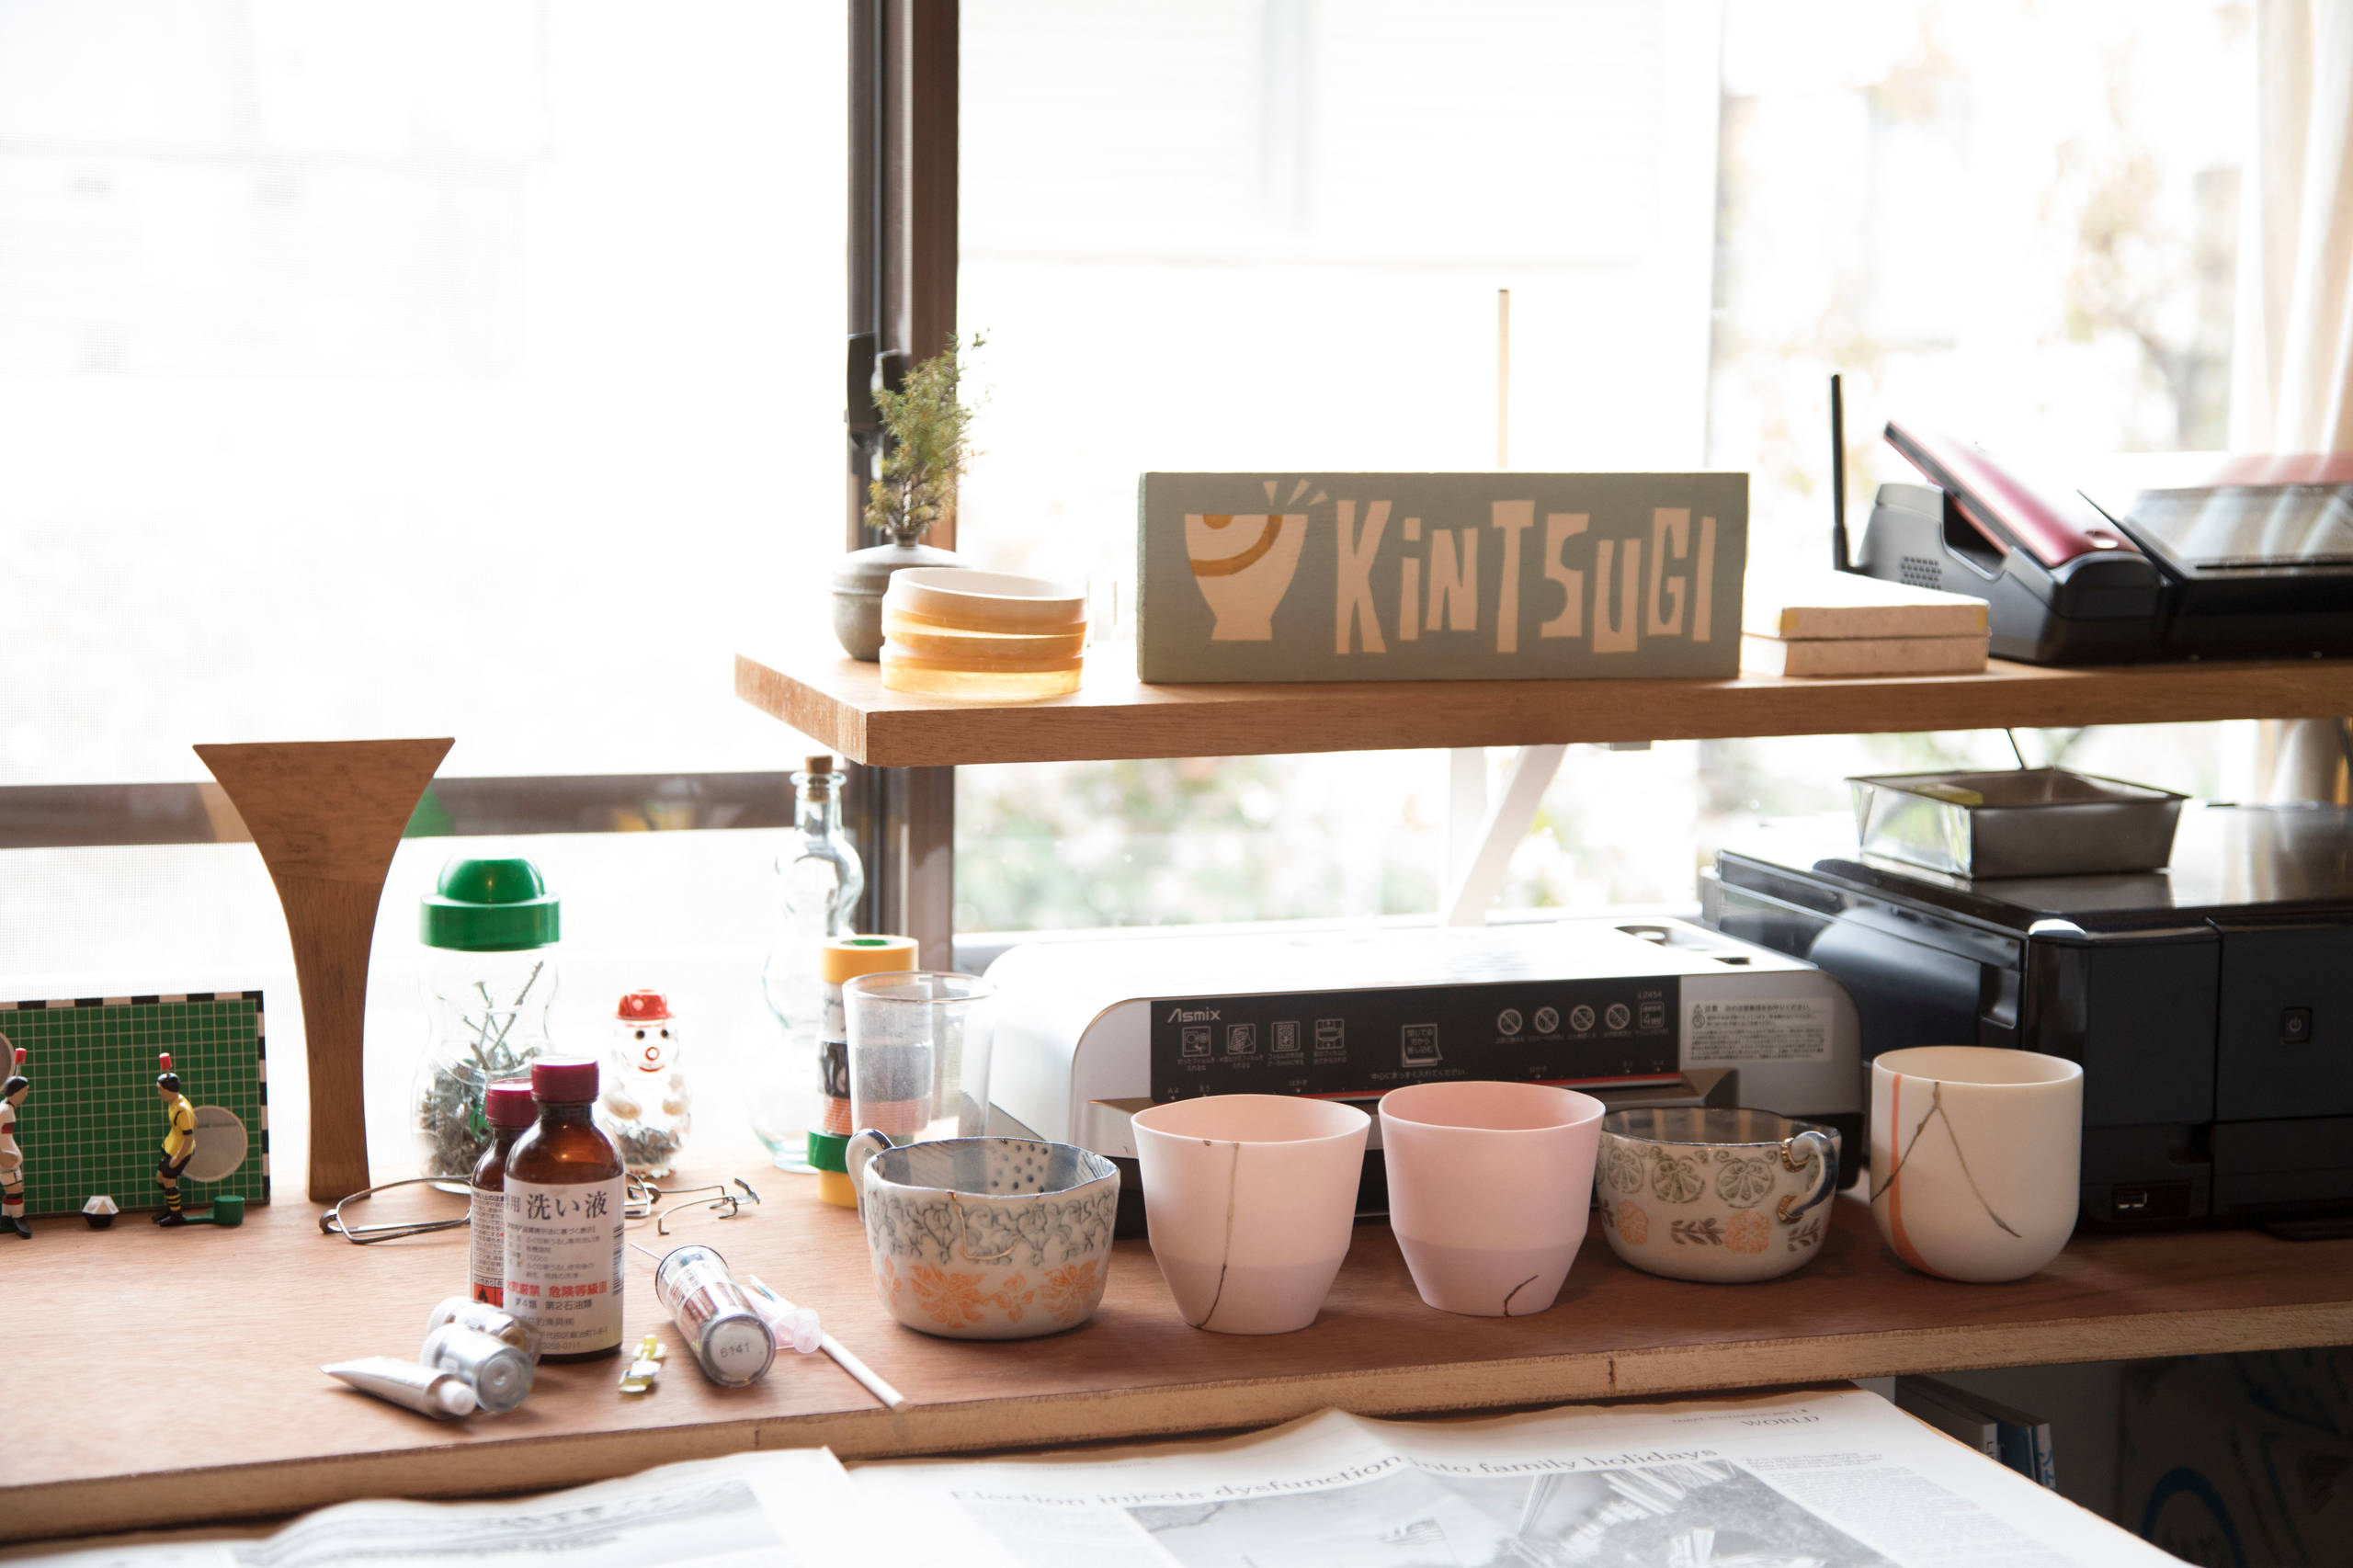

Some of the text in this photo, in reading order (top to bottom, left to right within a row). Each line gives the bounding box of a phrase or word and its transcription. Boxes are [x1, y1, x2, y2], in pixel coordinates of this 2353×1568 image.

[1167, 1006, 1222, 1023] Asmix
[527, 1191, 608, 1221] 洗い液
[720, 1342, 750, 1358] 6141
[1741, 1415, 1821, 1426] WORLD
[1096, 1491, 1207, 1506] injects
[1215, 1454, 1403, 1497] dysfunction
[1478, 1458, 1576, 1474] family
[1582, 1448, 1720, 1466] holidays
